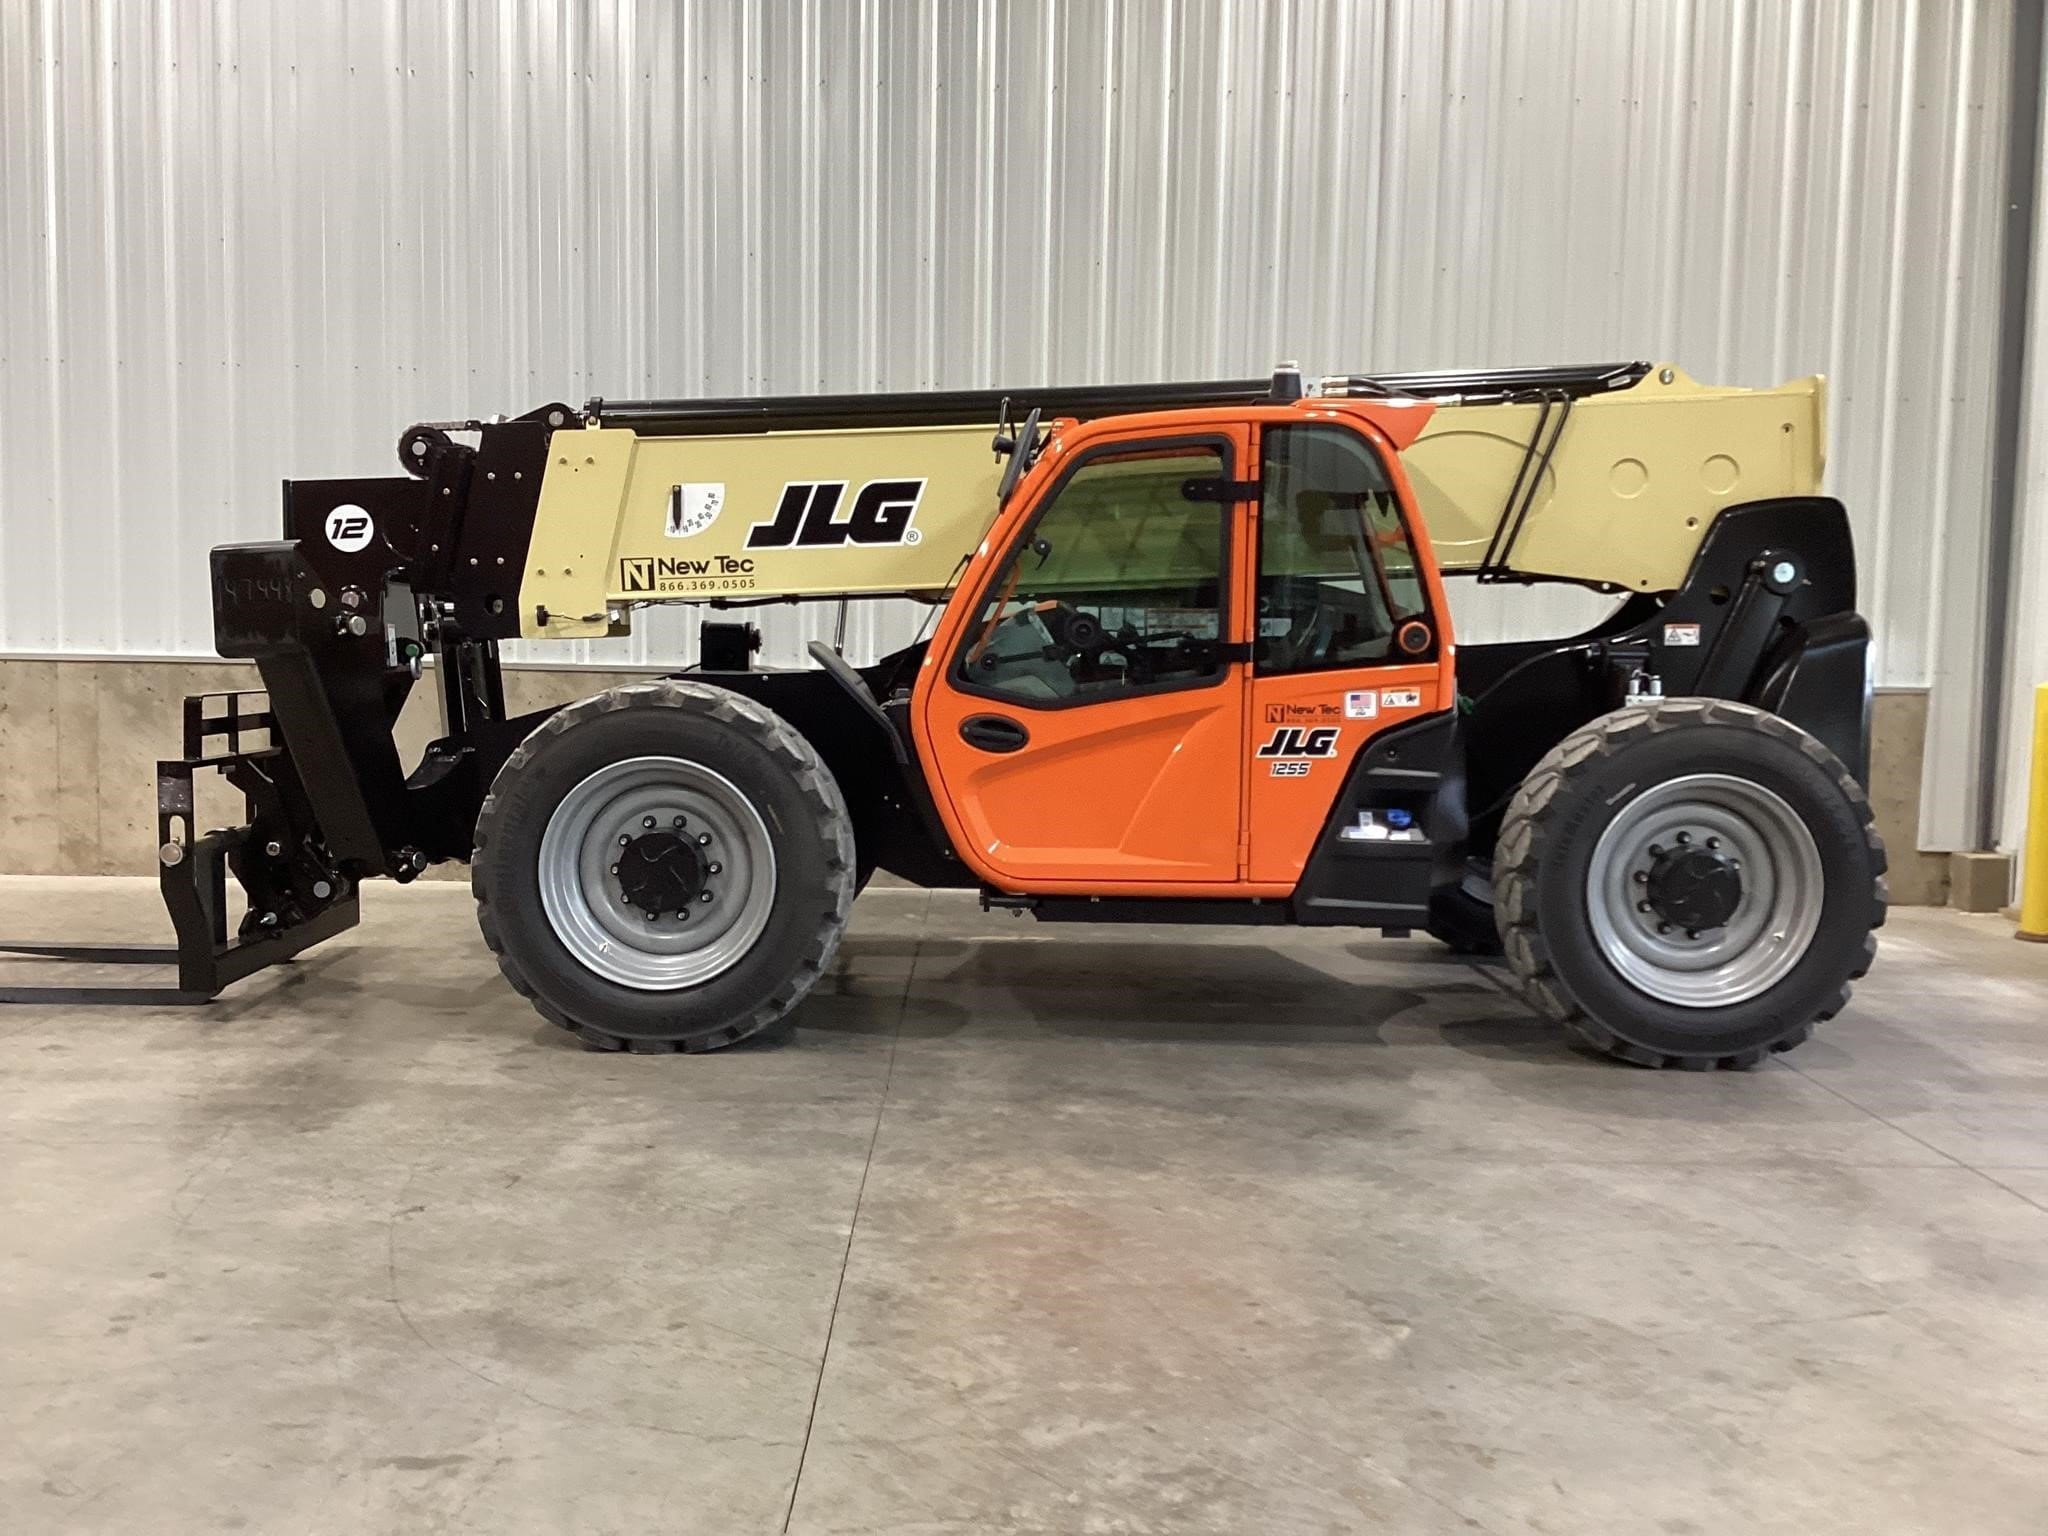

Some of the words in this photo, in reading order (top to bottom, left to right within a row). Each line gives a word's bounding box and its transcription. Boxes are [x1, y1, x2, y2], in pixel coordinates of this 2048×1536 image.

[747, 481, 922, 548] JLG
[331, 517, 369, 541] 12
[658, 557, 712, 578] New
[714, 555, 756, 576] Tec
[660, 578, 756, 592] 866.369.0505
[1286, 704, 1316, 715] New
[1318, 704, 1341, 715] Tec
[1259, 729, 1338, 756] JLG
[1271, 763, 1310, 775] 1255
